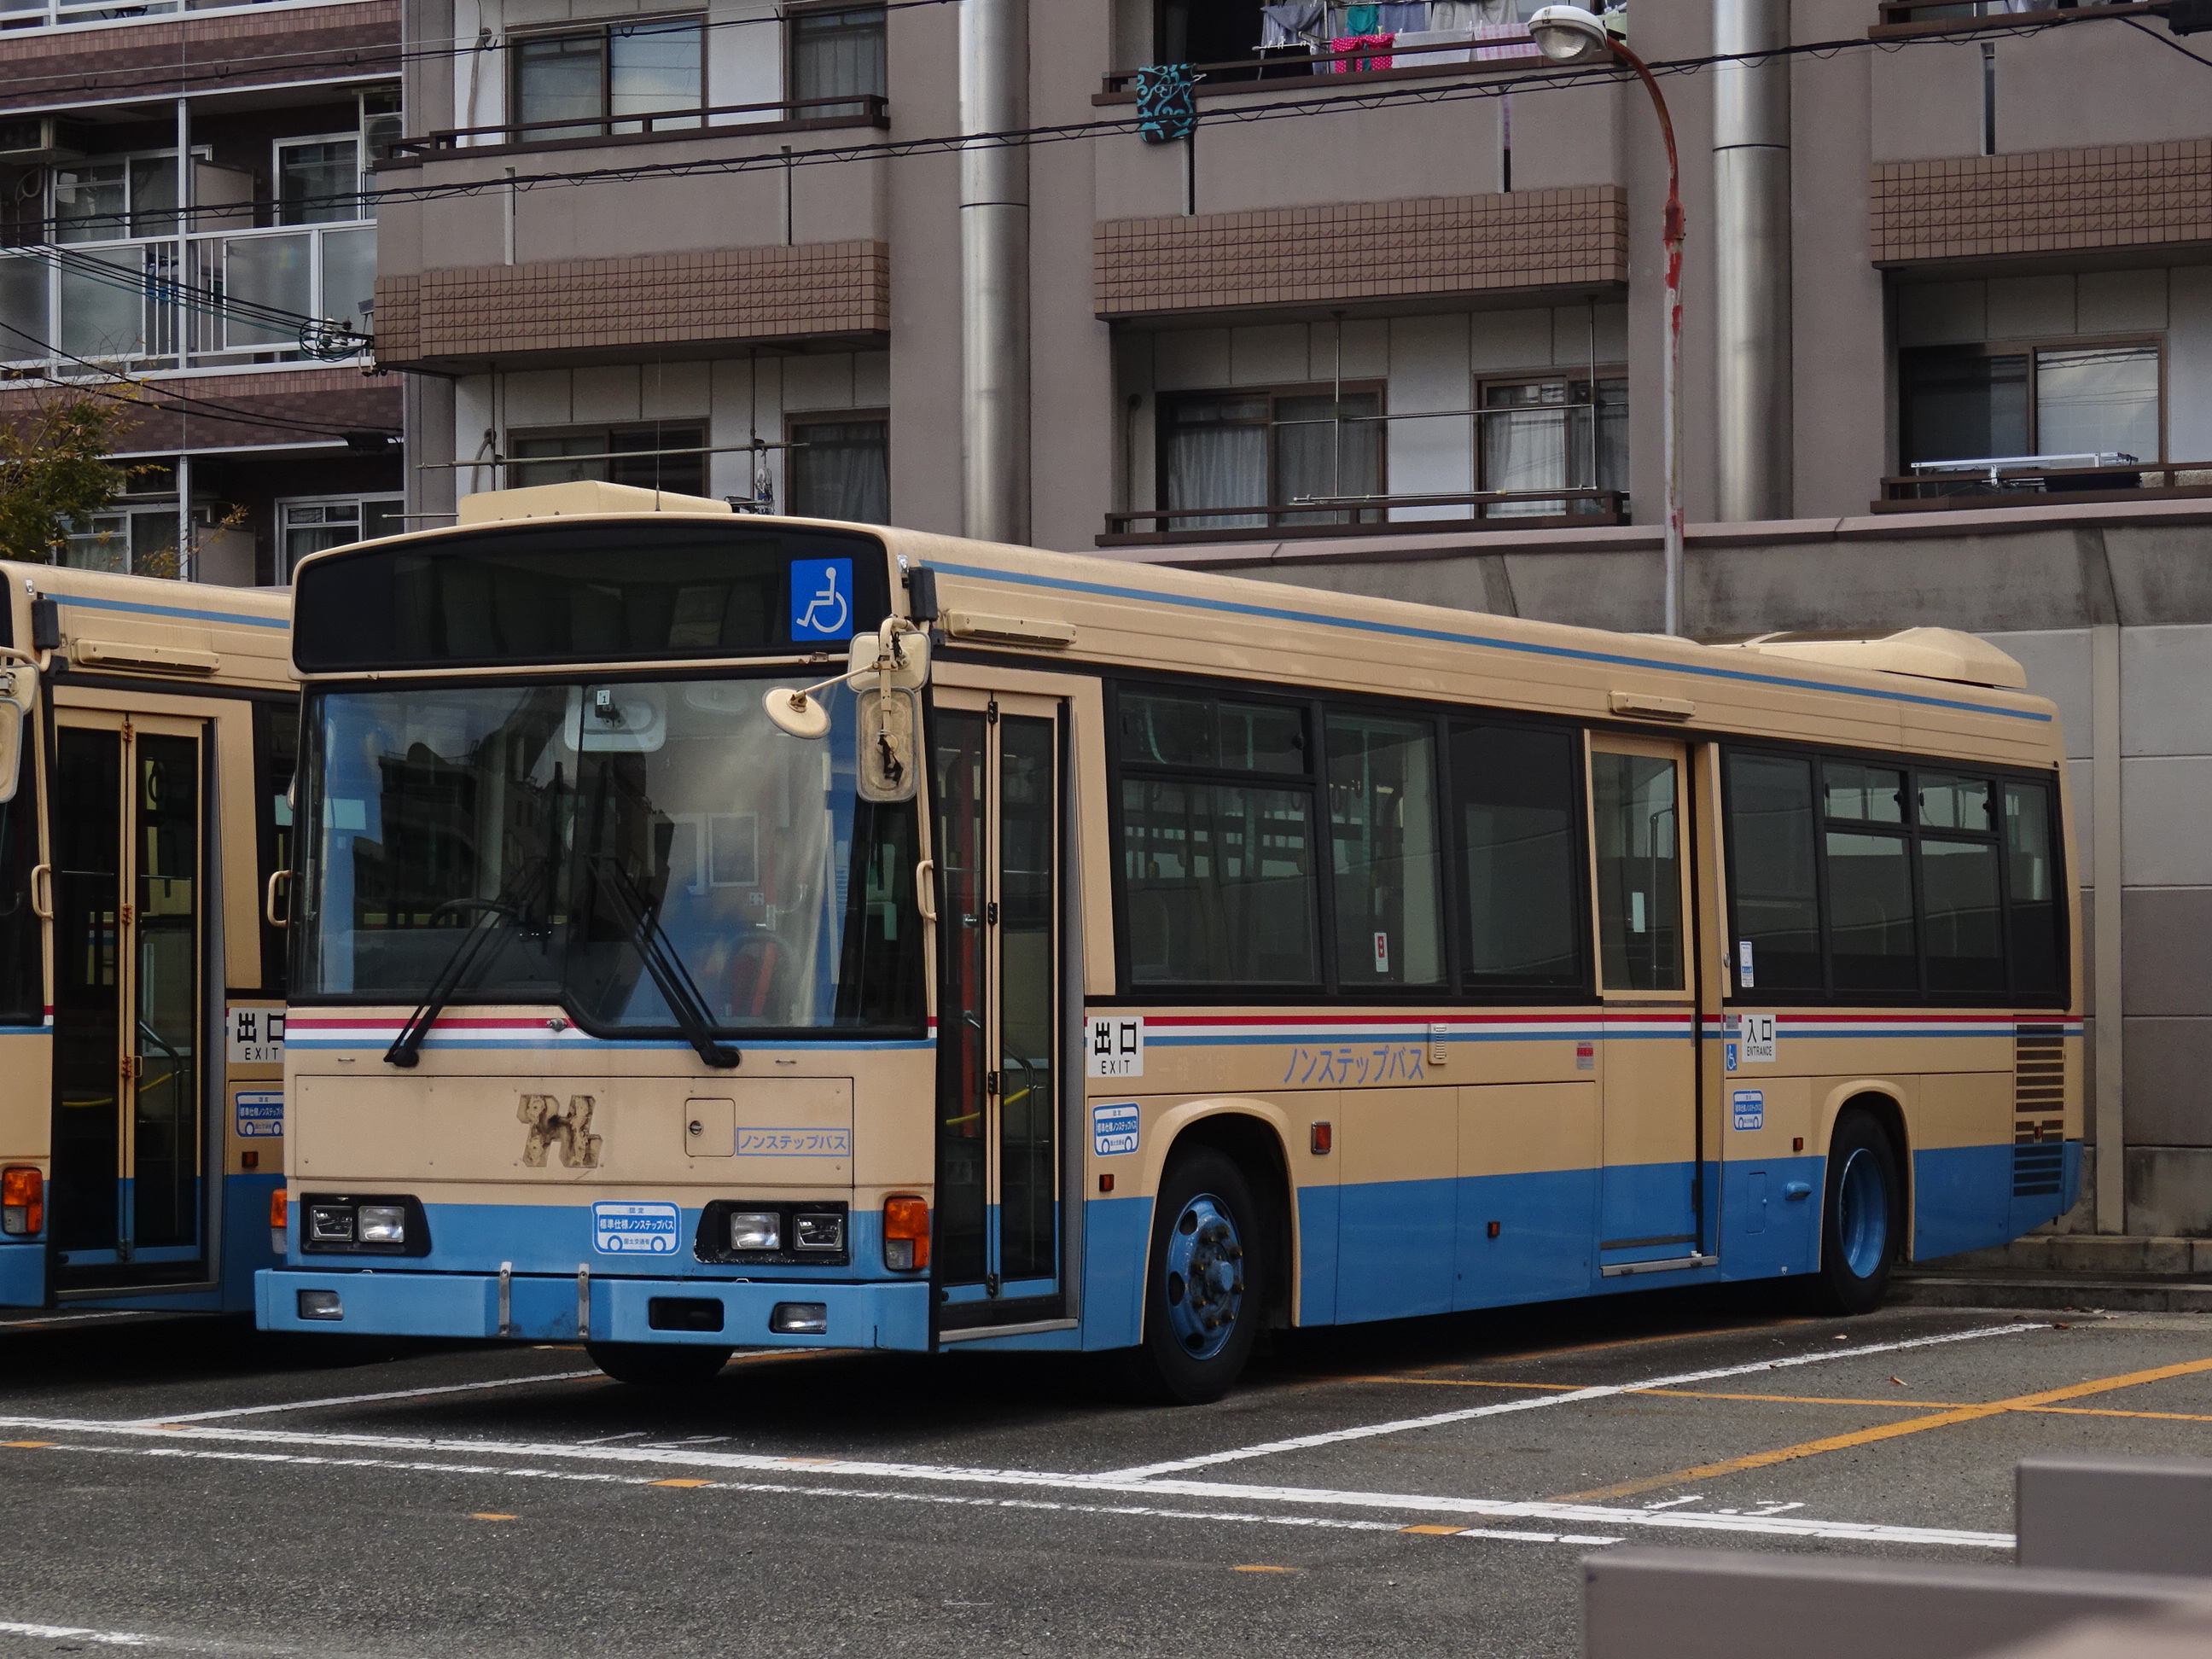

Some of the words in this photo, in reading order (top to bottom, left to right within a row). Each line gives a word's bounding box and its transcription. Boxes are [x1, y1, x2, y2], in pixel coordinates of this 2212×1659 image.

[237, 1012, 286, 1043] 出口
[1747, 1019, 1772, 1043] 入口
[1095, 1022, 1137, 1056] 出口
[245, 1047, 279, 1060] EXIT
[1747, 1046, 1773, 1057] ENTRANCE
[1101, 1060, 1130, 1074] EXIT
[1284, 1045, 1424, 1085] ノンステップバス
[740, 1134, 847, 1151] ノンステップバス
[600, 1219, 674, 1230] 標準仕様ノンステップバス
